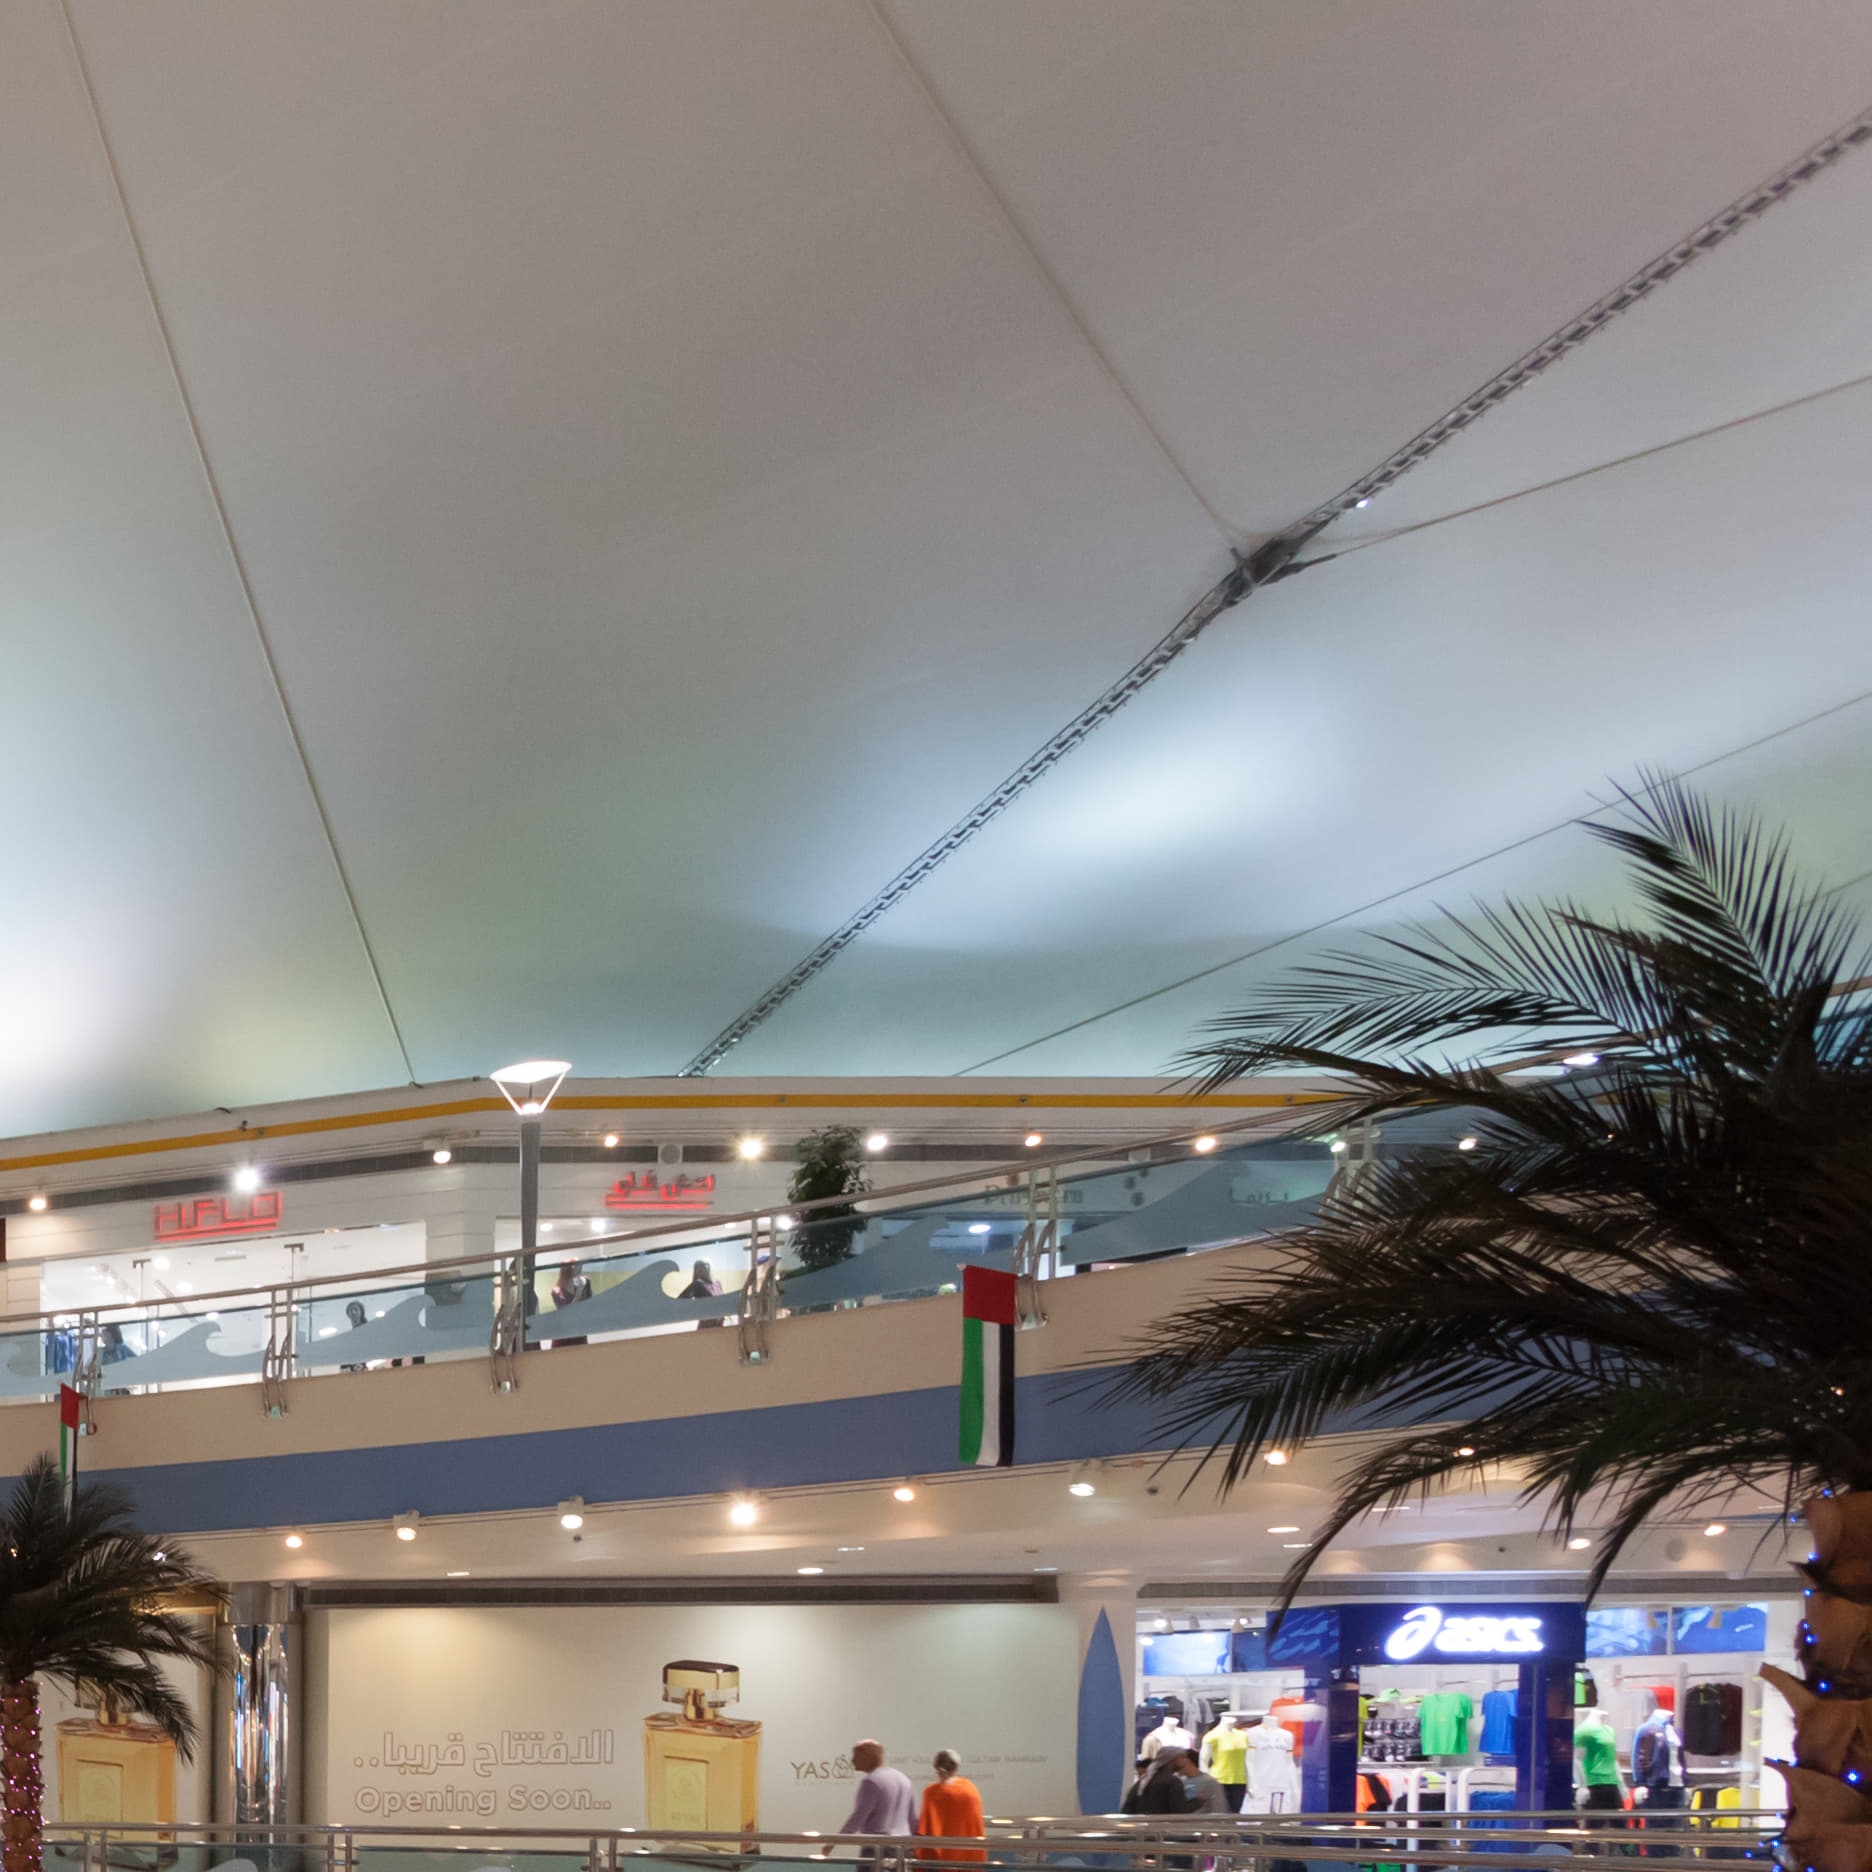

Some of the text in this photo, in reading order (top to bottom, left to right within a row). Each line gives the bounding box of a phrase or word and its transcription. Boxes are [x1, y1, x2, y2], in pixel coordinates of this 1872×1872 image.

[472, 1728, 615, 1778] الافتتاح
[790, 1761, 831, 1780] YAS
[354, 1784, 498, 1818] Opening
